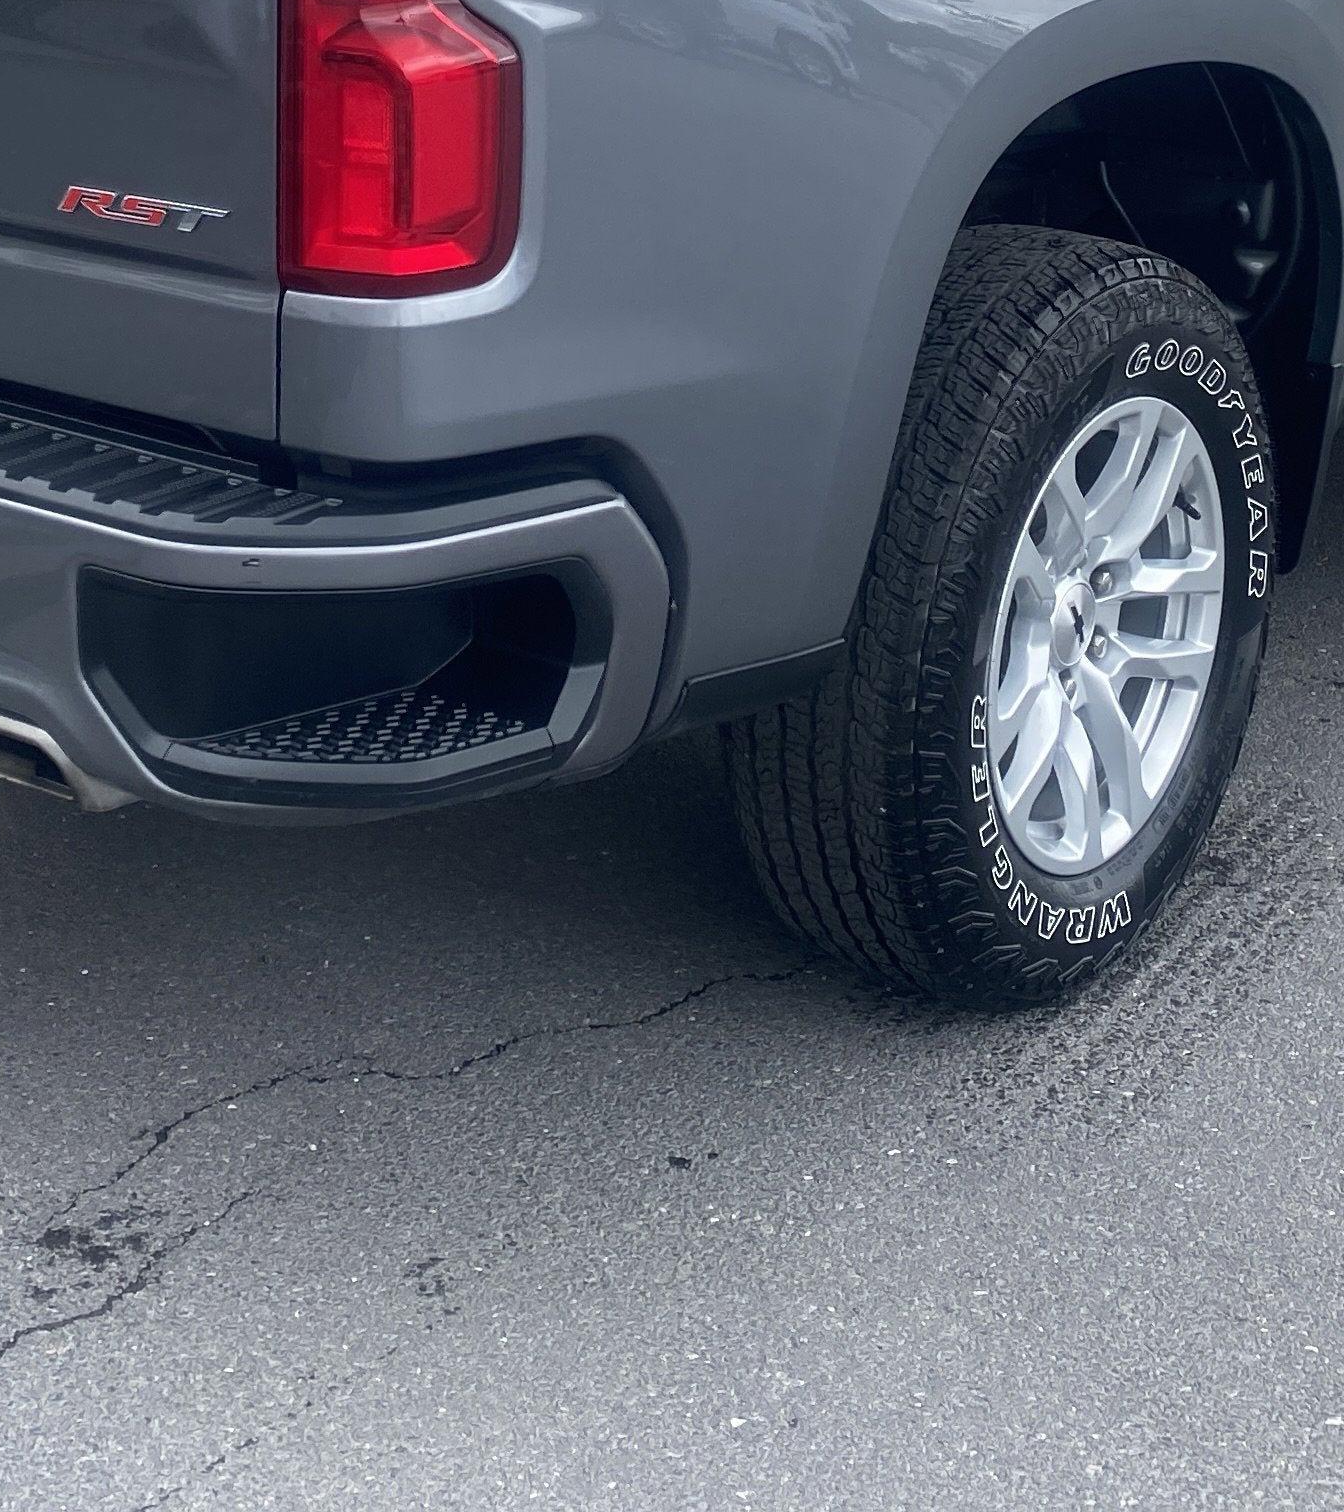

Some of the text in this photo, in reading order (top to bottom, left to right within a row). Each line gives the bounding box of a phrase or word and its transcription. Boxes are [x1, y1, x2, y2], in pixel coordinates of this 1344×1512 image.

[56, 184, 232, 233] RST
[1125, 337, 1268, 599] GOODYEAR
[970, 694, 1132, 945] WRANGLER
